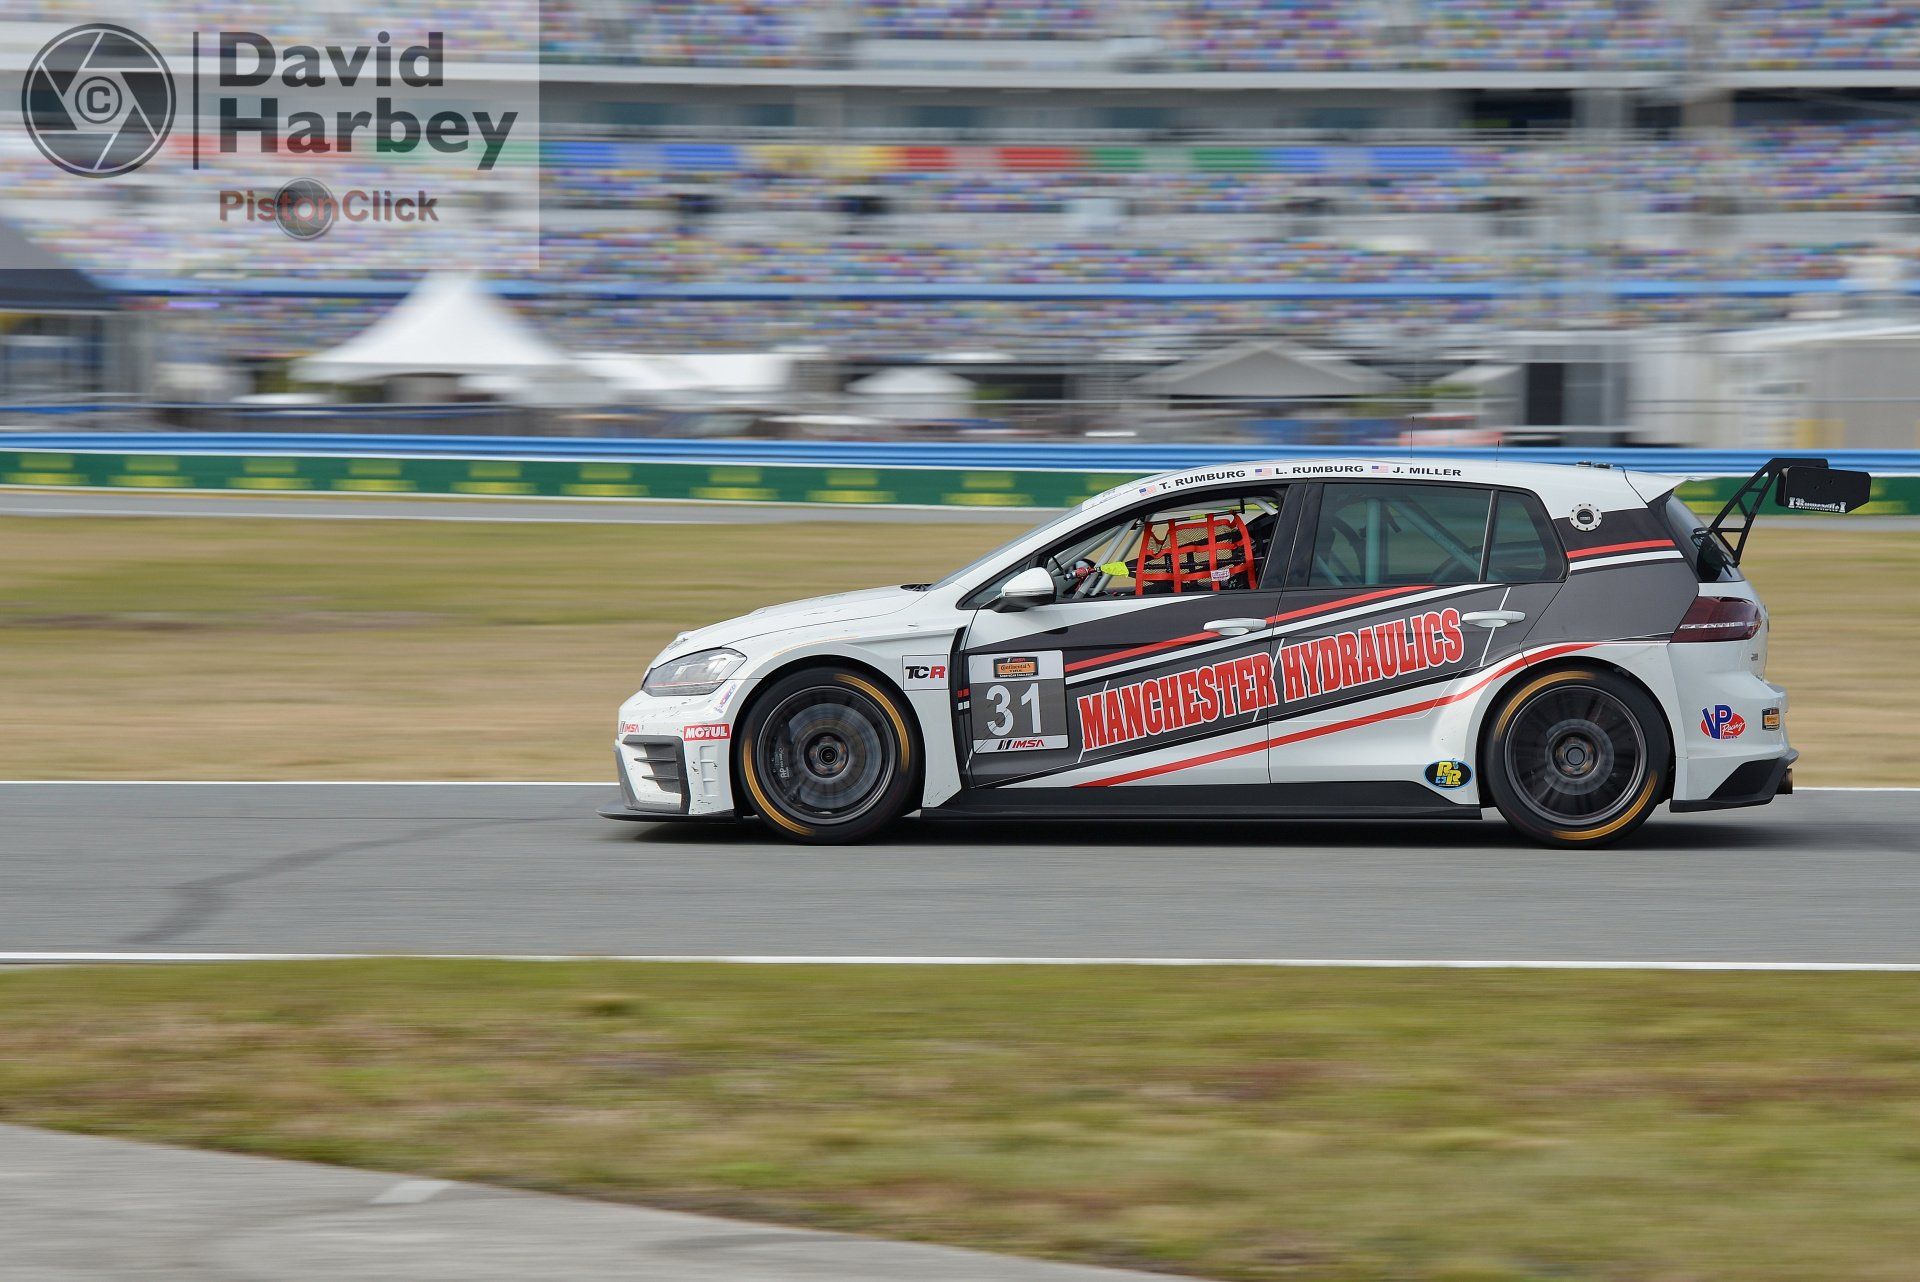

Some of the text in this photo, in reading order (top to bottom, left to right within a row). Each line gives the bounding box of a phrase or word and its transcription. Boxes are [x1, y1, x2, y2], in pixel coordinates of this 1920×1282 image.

[1275, 465, 1364, 475] L. RUMBURG
[1393, 466, 1462, 477] J. MILLER
[1159, 470, 1246, 490] T. RUMBURG
[905, 665, 946, 680] TCR
[1077, 607, 1465, 751] MANCHESTER HYDRAULICS
[986, 682, 1042, 737] 31
[1701, 703, 1733, 740] VP
[685, 726, 728, 739] MOTUL
[1012, 738, 1045, 749] IMSA
